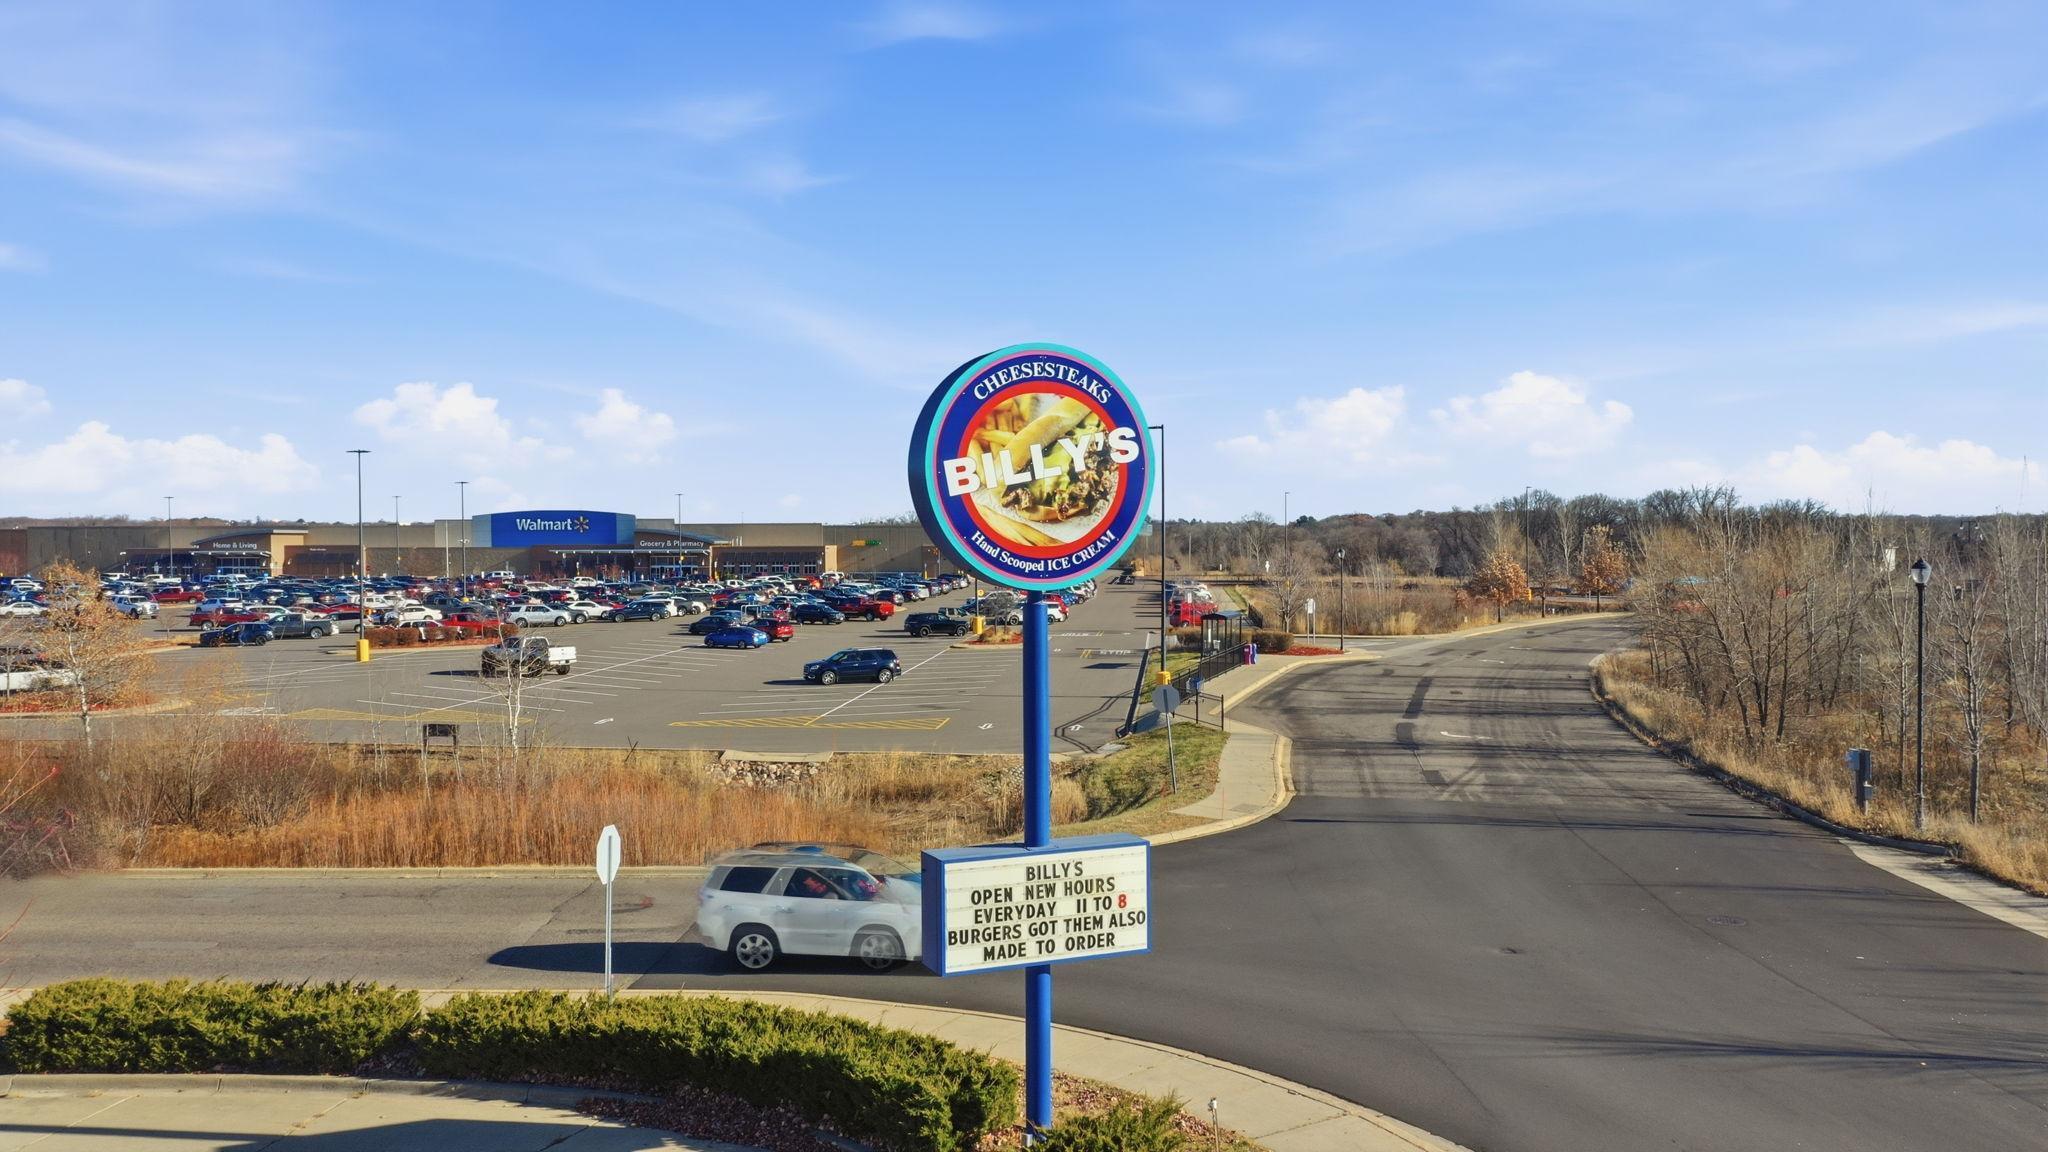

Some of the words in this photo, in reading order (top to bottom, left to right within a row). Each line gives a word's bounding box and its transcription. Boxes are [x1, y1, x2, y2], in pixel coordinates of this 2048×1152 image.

[973, 361, 1112, 404] CHEESESTEAKS
[943, 426, 1140, 497] BILLY'S
[516, 518, 572, 531] Walmart
[239, 542, 258, 550] Living
[639, 539, 665, 548] Grocery
[667, 539, 672, 547] &
[971, 530, 999, 557] Hand
[999, 552, 1045, 572] Scooped
[1047, 556, 1071, 571] ICE
[1071, 530, 1116, 565] CREAM
[1026, 861, 1083, 881] BILLY'S
[970, 887, 1013, 905] OPEN
[1025, 882, 1056, 900] NEW
[1064, 877, 1116, 896] HOURS
[974, 901, 1057, 924] EVERYDAY
[1093, 896, 1112, 911] TO
[1118, 894, 1127, 909] 8
[948, 924, 1022, 946] BURGERS
[1028, 920, 1058, 936] GOT
[1063, 915, 1103, 934] THEM
[1109, 910, 1146, 928] ALSO
[983, 943, 1027, 962] MADE
[1036, 939, 1055, 955] TO
[1065, 933, 1115, 951] ORDER
